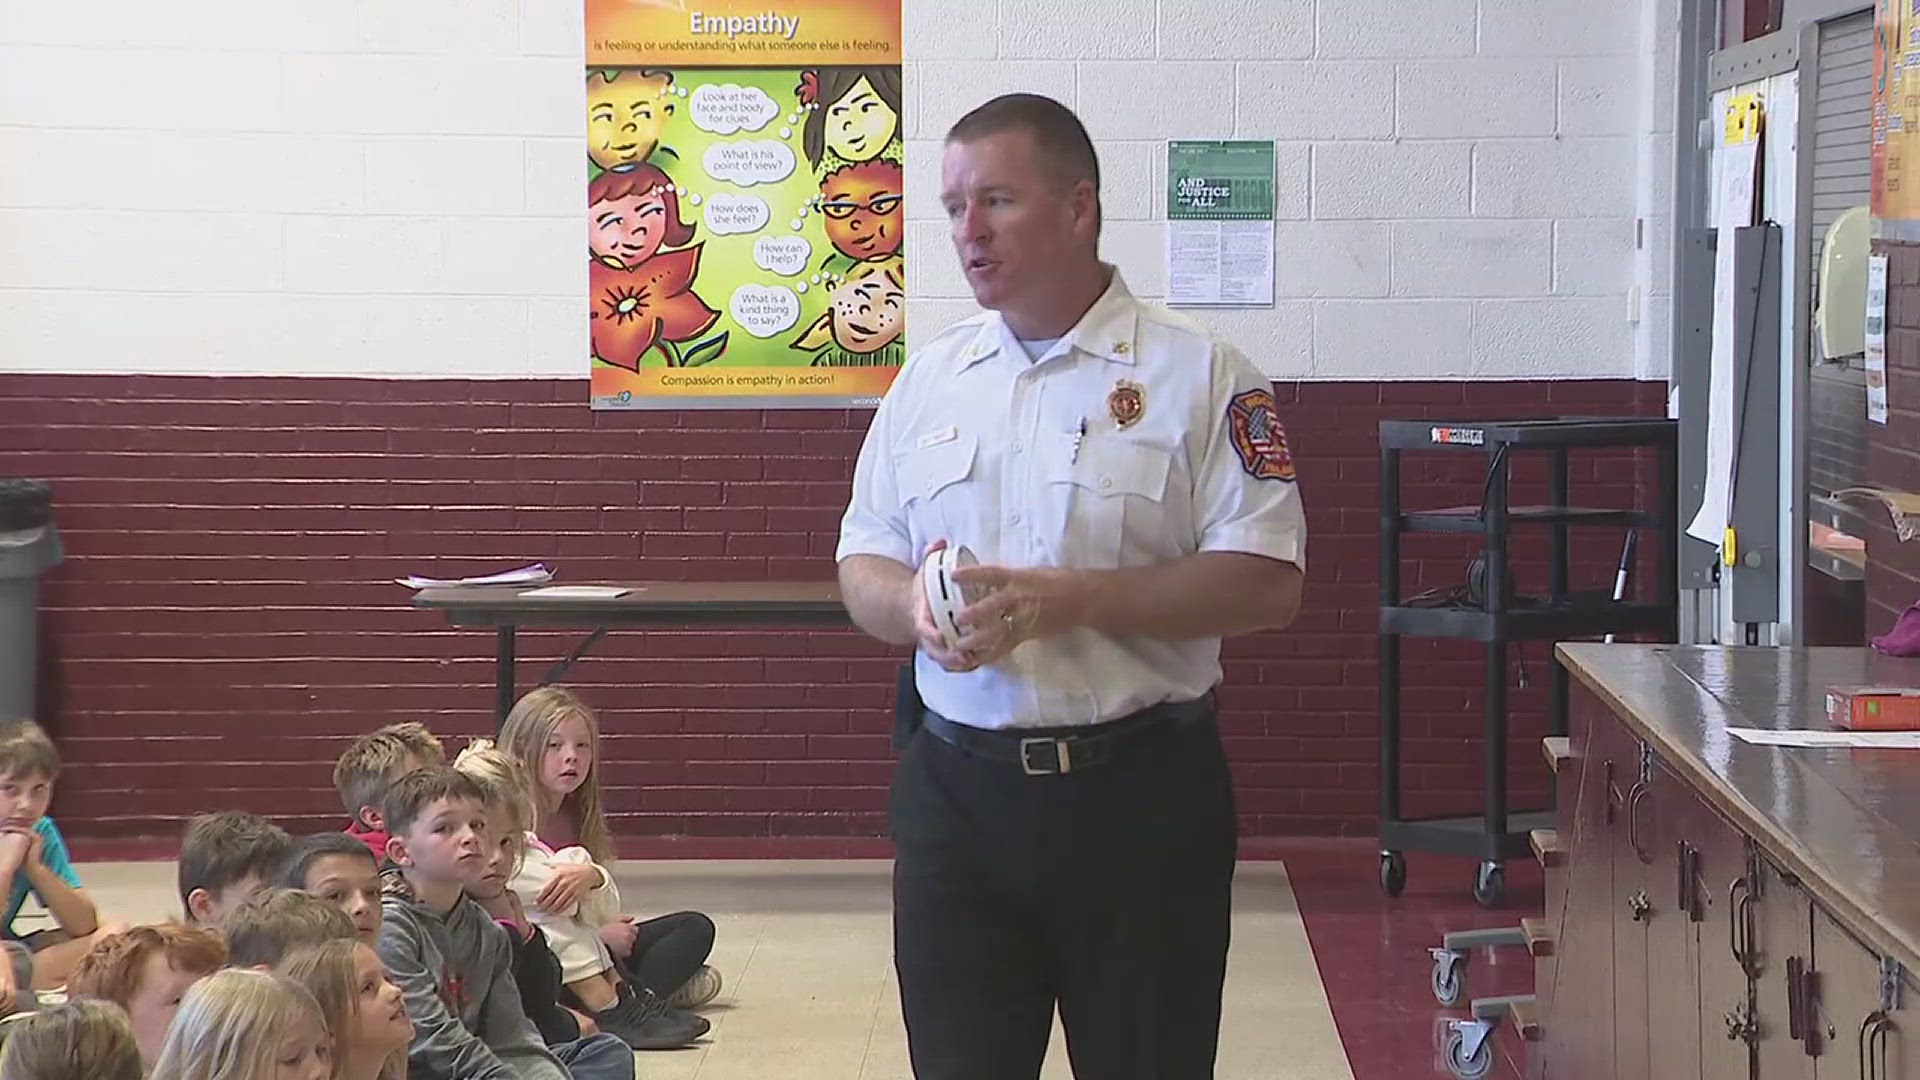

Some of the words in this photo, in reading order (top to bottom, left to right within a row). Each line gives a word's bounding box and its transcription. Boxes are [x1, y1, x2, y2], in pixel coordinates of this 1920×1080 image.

[691, 9, 799, 40] Empathy
[593, 39, 602, 51] is
[604, 39, 641, 53] feeling
[644, 41, 655, 51] or
[659, 39, 736, 53] understanding
[738, 39, 766, 51] what
[768, 41, 817, 51] someone
[819, 39, 840, 51] else
[842, 39, 850, 51] is
[702, 92, 726, 102] Look
[728, 93, 739, 102] at
[741, 92, 758, 102] her
[696, 102, 717, 113] face
[719, 102, 738, 112] and
[740, 102, 765, 115] body
[709, 113, 723, 123] for
[721, 149, 749, 159] What
[751, 149, 758, 159] is
[760, 149, 774, 159] his
[713, 160, 740, 171] point
[742, 160, 752, 170] of
[753, 160, 783, 170] view?
[1177, 177, 1205, 188] AND
[1177, 186, 1231, 198] JUSTICE
[1191, 197, 1216, 207] ALL
[711, 203, 734, 213] How
[736, 203, 759, 213] does
[714, 214, 730, 224] she
[732, 213, 757, 224] feel?
[761, 244, 784, 253] How
[786, 245, 803, 253] can
[771, 253, 798, 265] help?
[741, 294, 769, 303] What
[771, 293, 778, 303] is
[780, 295, 786, 303] a
[739, 304, 761, 314] kind
[763, 304, 789, 317] thing
[748, 316, 759, 325] to
[760, 315, 781, 327] say?
[660, 374, 724, 387] Compassion
[726, 374, 734, 385] is
[736, 374, 783, 388] empathy
[785, 374, 796, 385] in
[798, 374, 835, 385] action!
